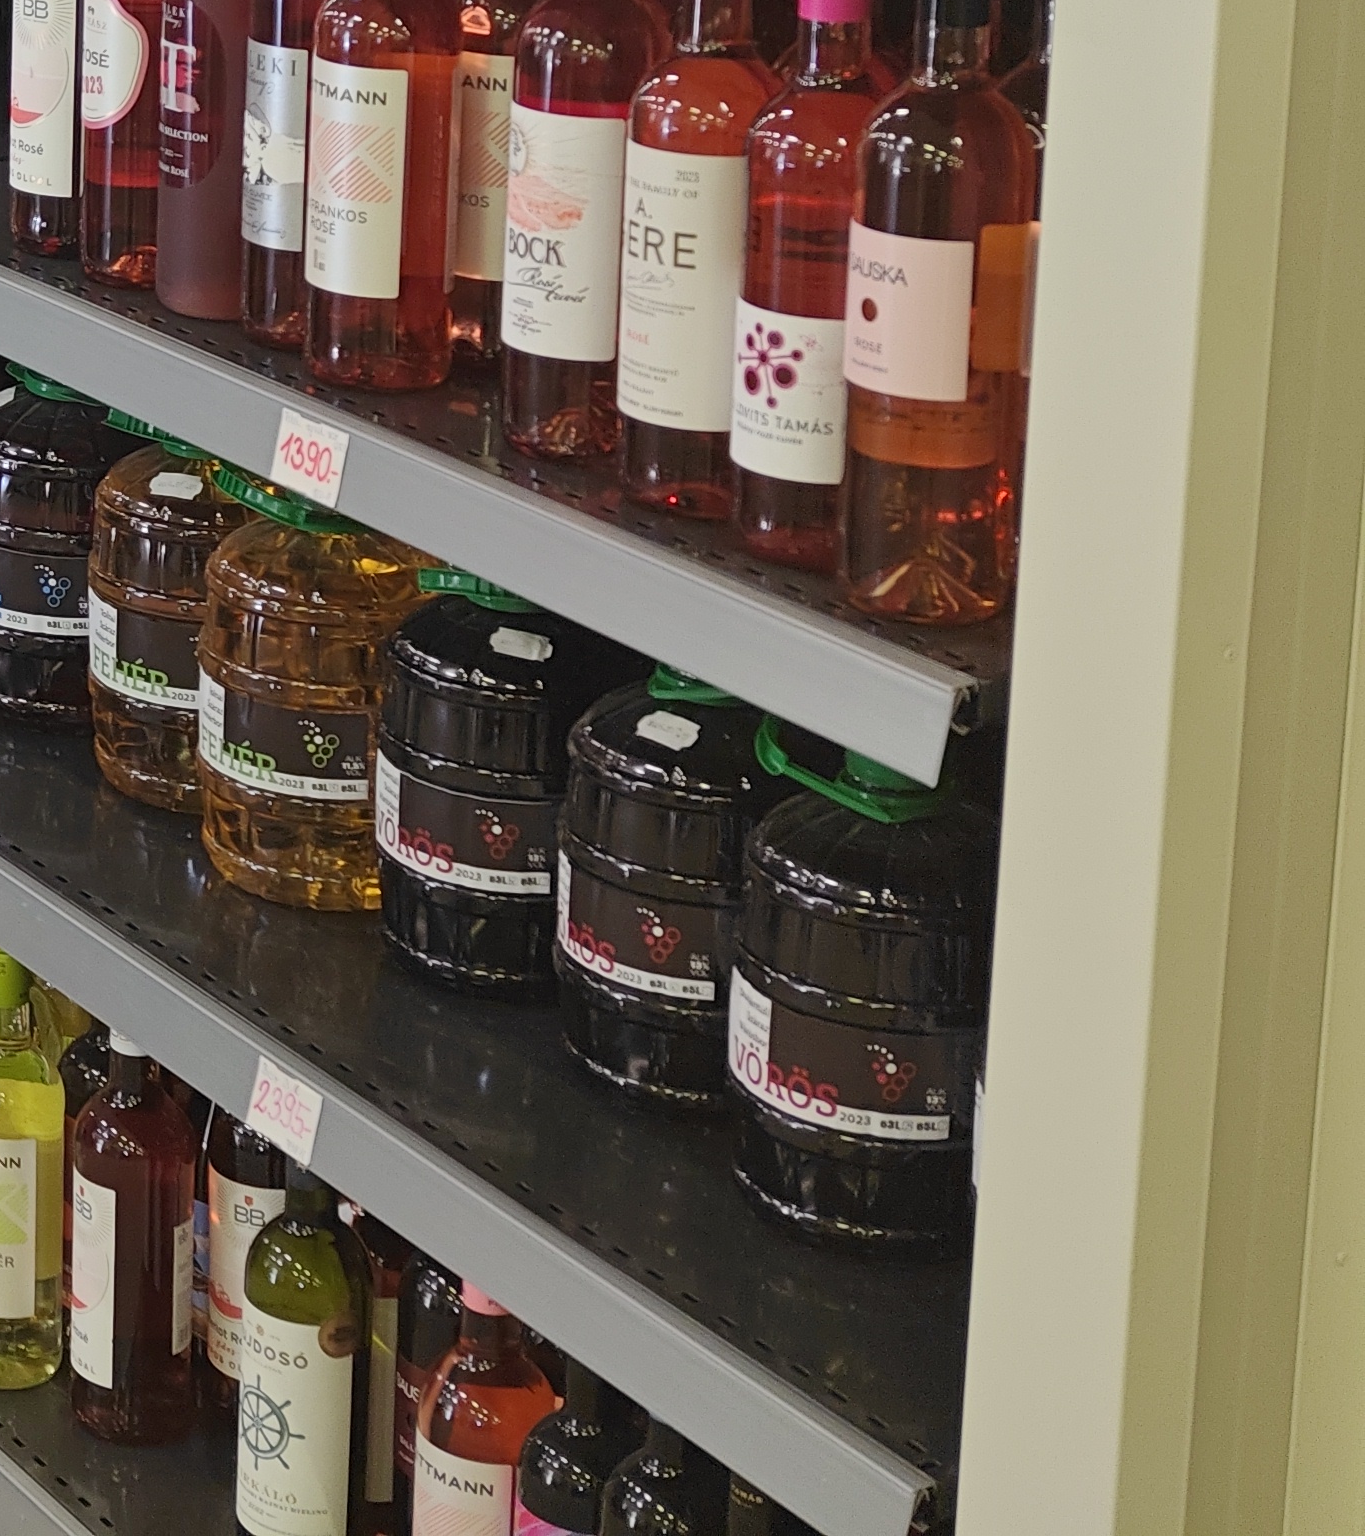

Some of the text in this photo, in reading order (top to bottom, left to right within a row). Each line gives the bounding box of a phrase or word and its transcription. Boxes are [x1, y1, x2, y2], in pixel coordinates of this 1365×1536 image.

[19, 139, 44, 155] Rosé
[510, 228, 567, 268] BOCK
[627, 221, 699, 270] ERE
[775, 413, 834, 436] TAMÁS
[6, 613, 27, 625] 2023
[92, 641, 172, 700] FEHÉR
[171, 692, 196, 703] 2023
[202, 723, 278, 784] FEHÉR
[279, 777, 304, 789] 2023
[377, 808, 454, 873] VÖRÖS
[455, 868, 482, 882] 2023
[735, 1034, 839, 1117] VÖRÖS
[839, 1113, 871, 1126] 2023
[235, 1205, 266, 1226] BB
